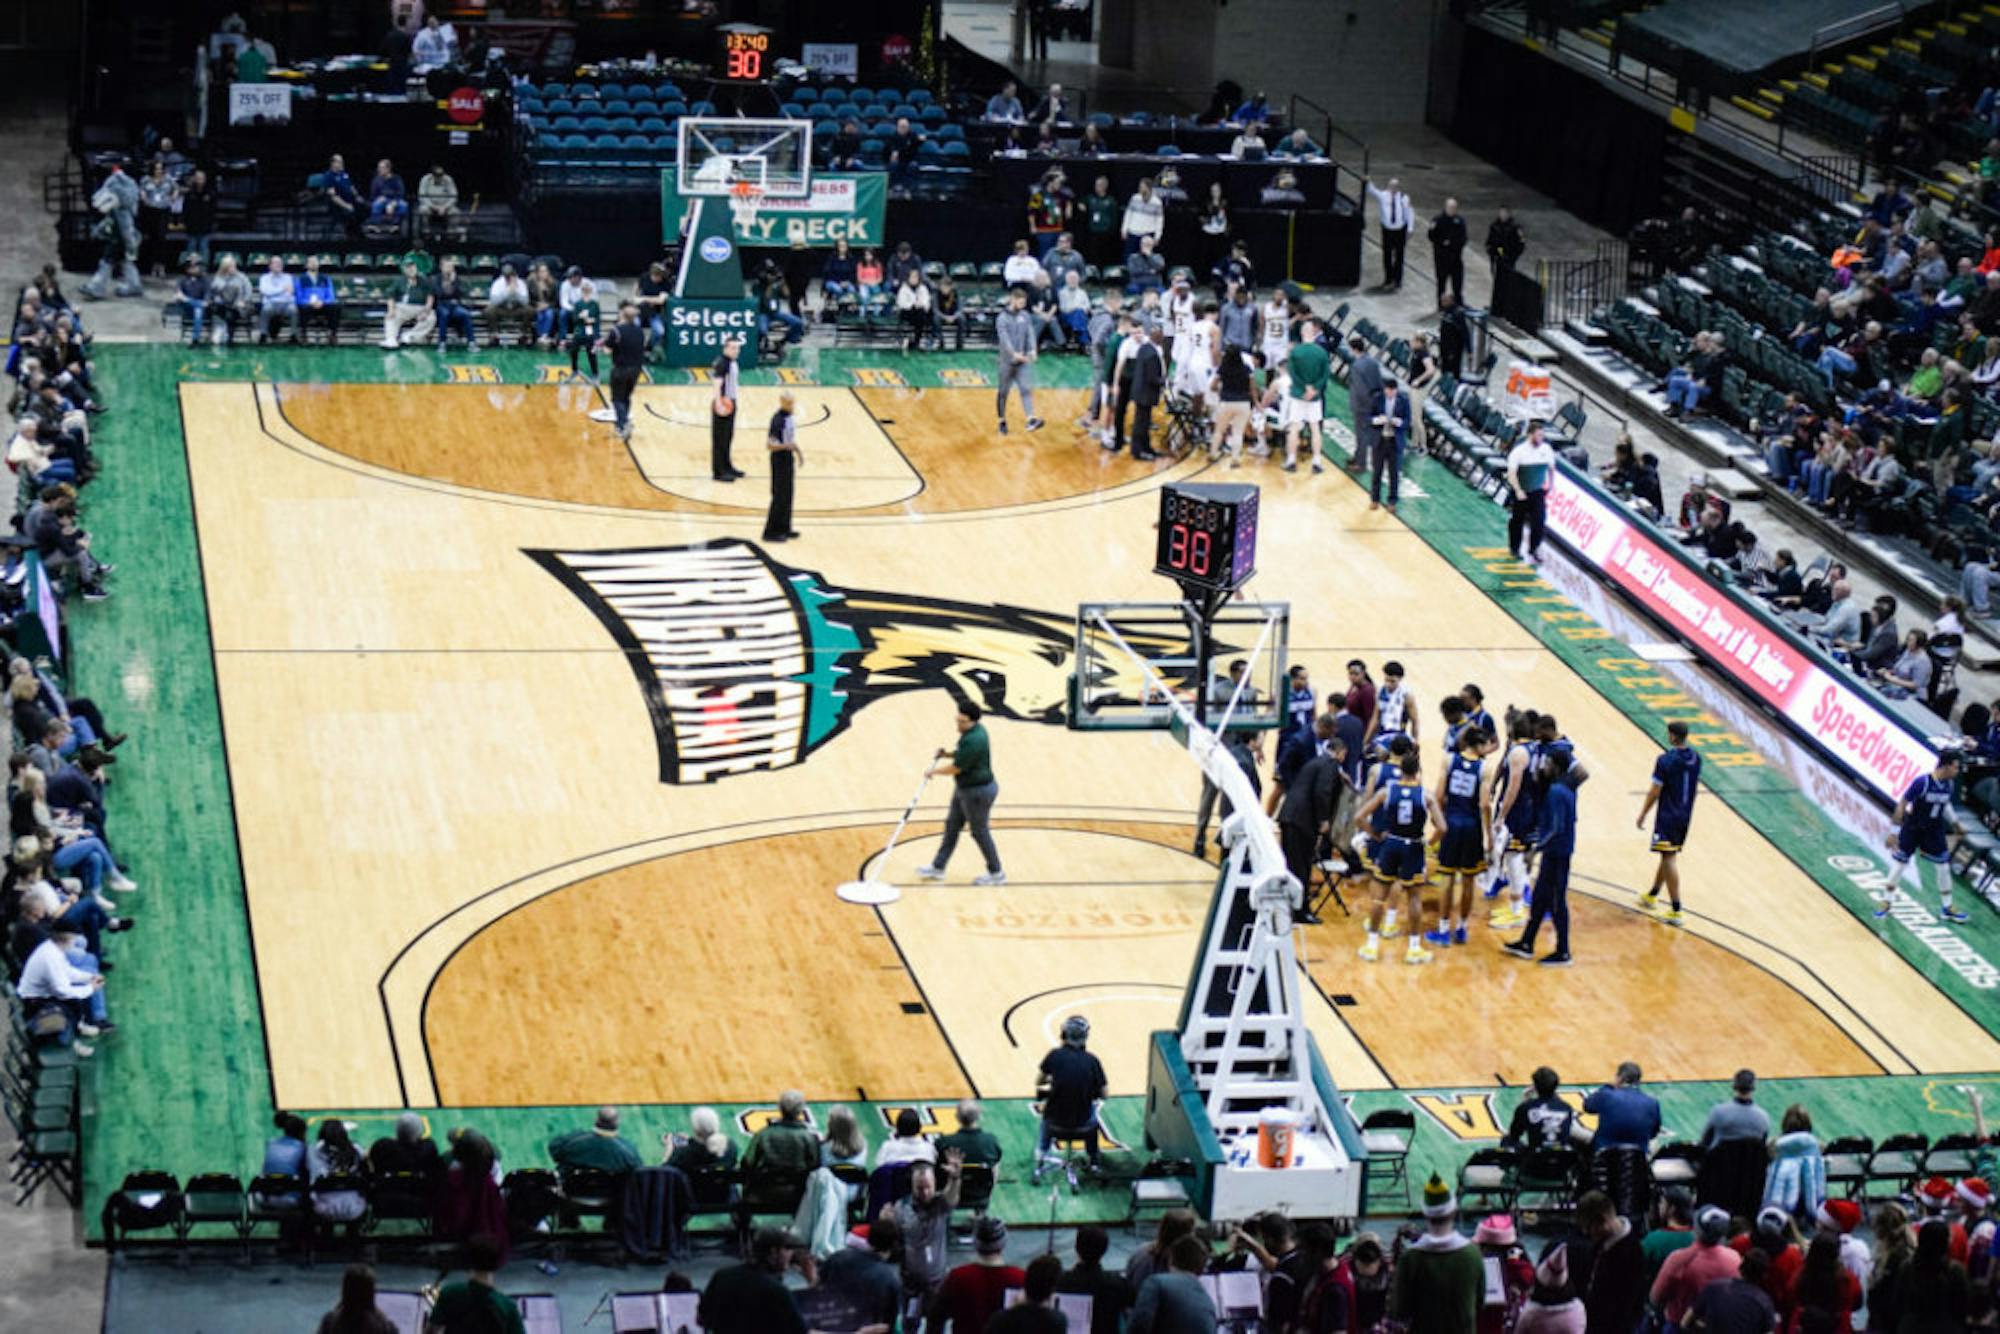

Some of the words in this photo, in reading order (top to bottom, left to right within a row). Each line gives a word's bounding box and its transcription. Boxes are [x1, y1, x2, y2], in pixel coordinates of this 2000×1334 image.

[726, 34, 768, 51] 13:40
[727, 51, 760, 78] 30
[450, 98, 481, 110] SALE
[786, 218, 868, 240] DECK
[671, 306, 756, 327] Select
[1169, 523, 1211, 575] 30
[554, 542, 804, 679] WRIGHT
[1596, 658, 1767, 767] CENTER
[663, 680, 806, 785] STATE
[1811, 684, 1922, 798] Speedway
